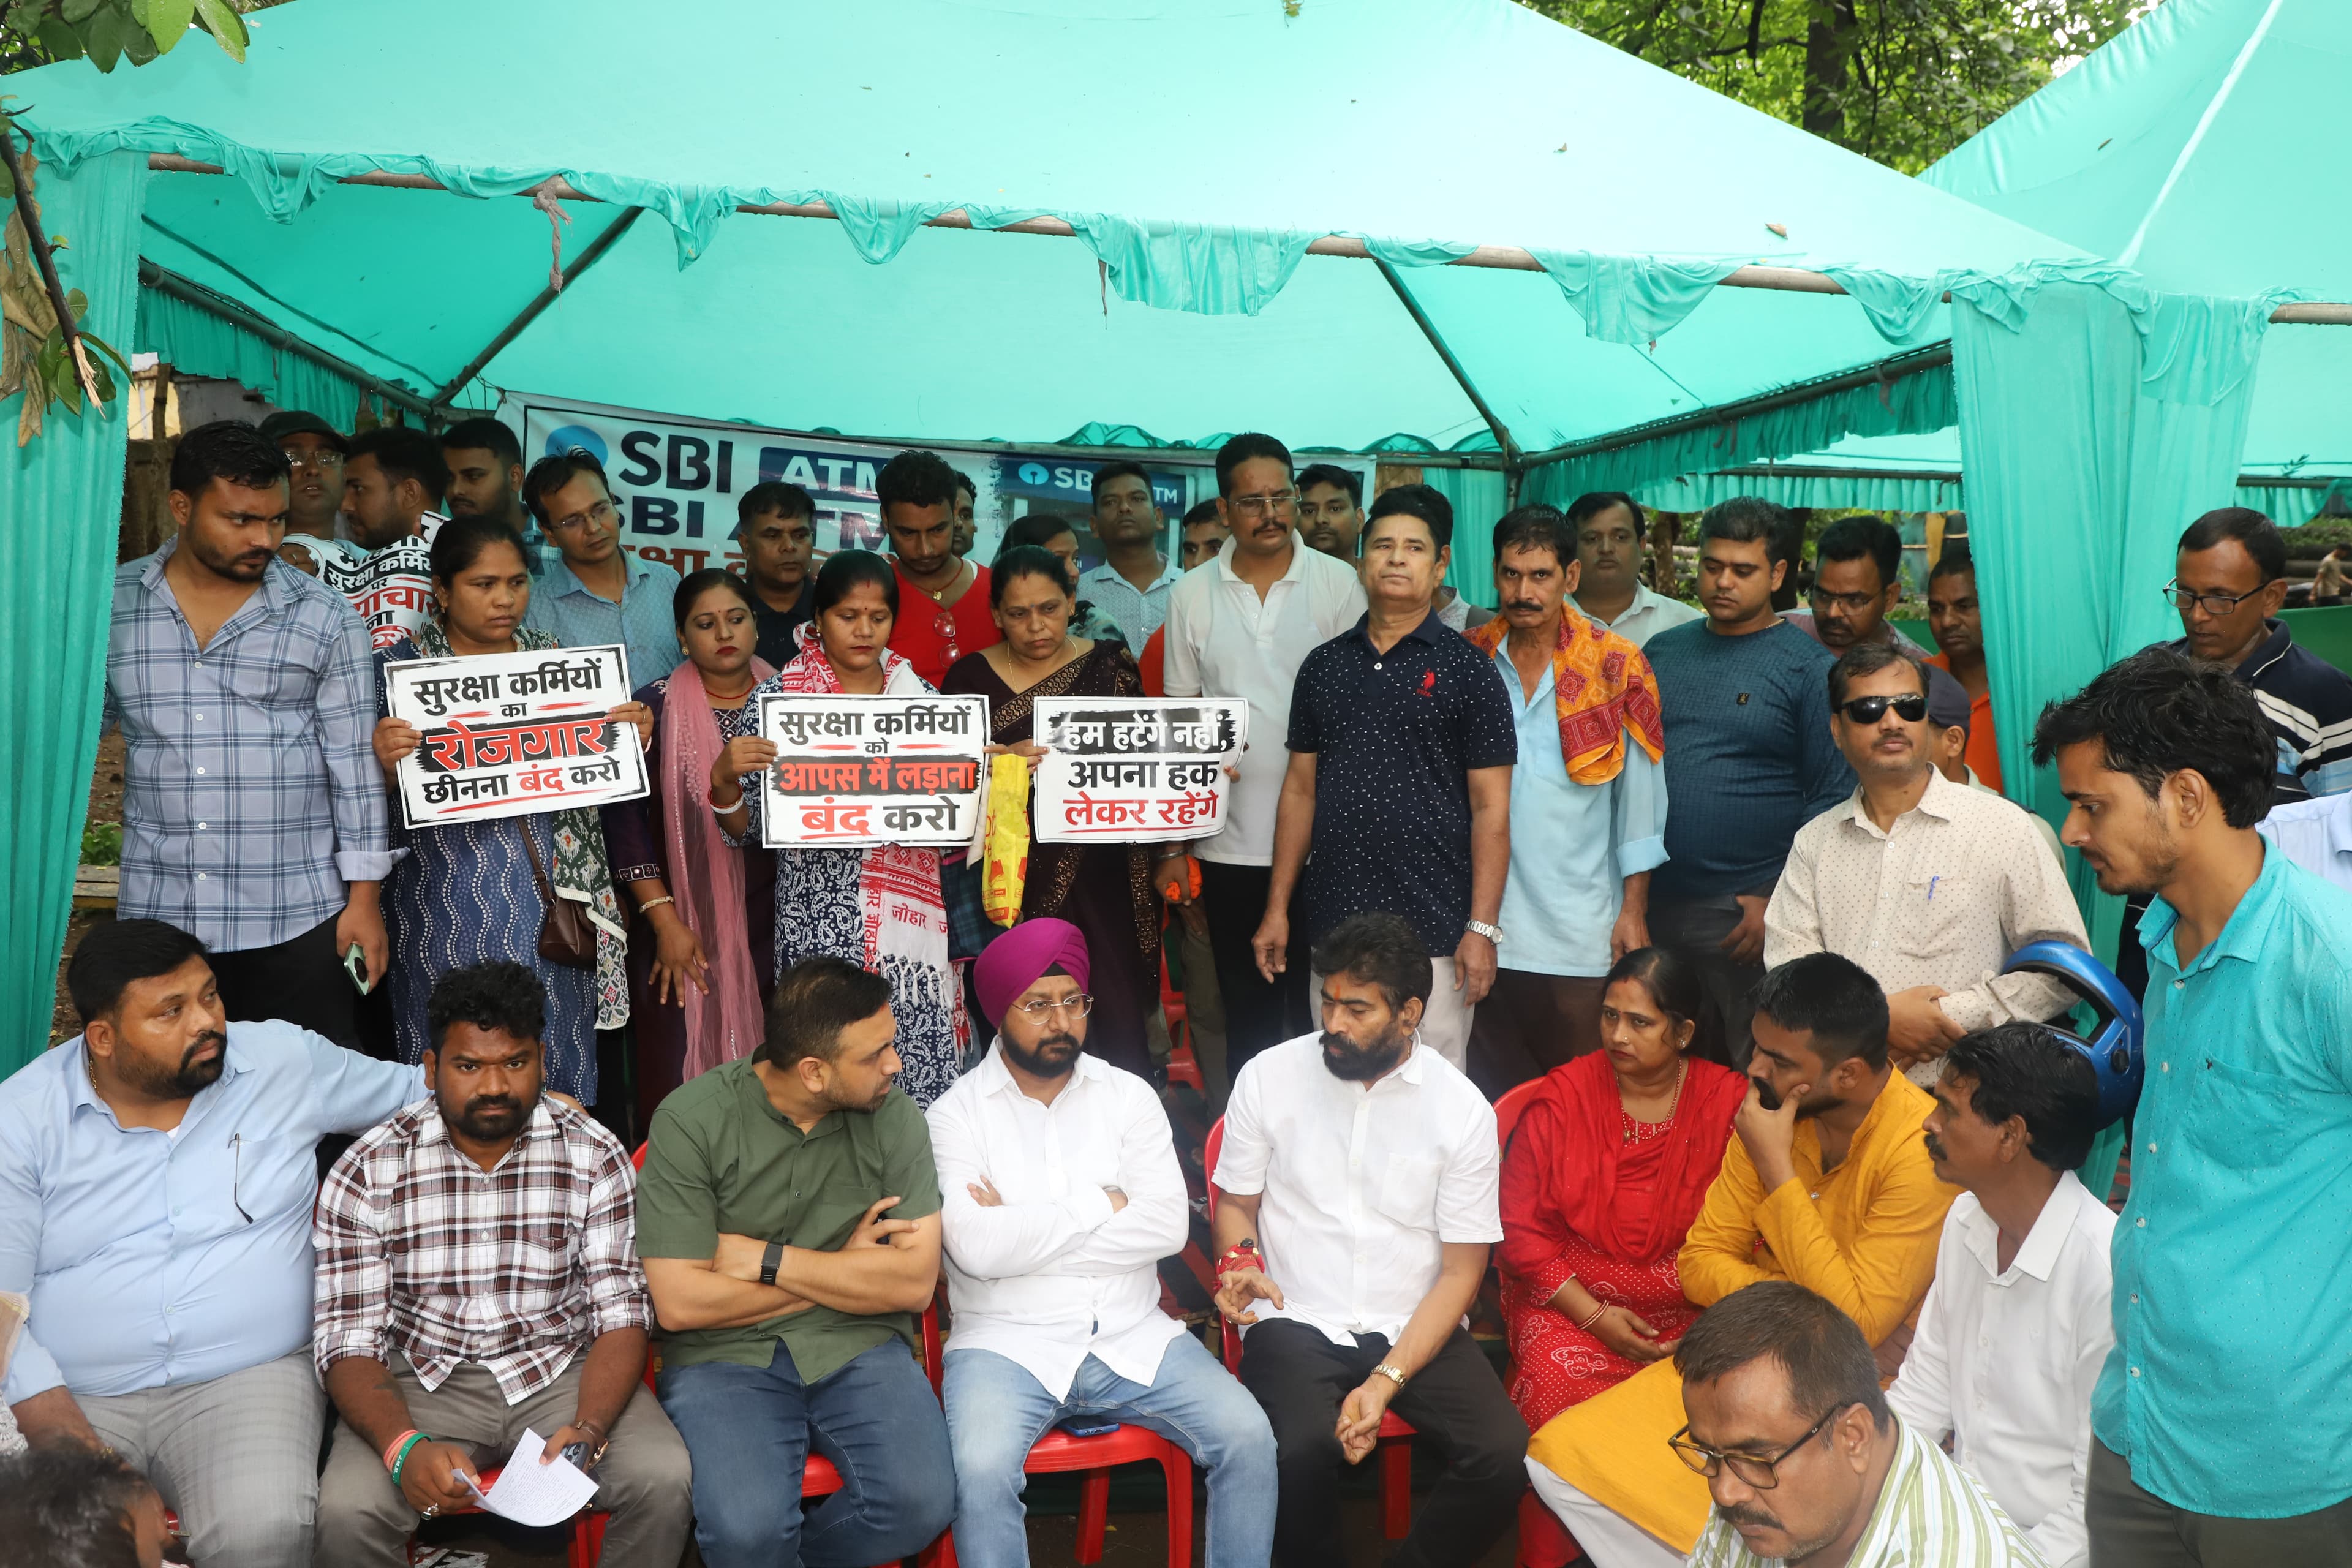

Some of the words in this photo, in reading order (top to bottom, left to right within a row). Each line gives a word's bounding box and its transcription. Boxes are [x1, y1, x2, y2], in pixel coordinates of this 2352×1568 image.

[619, 431, 733, 493] SBI
[614, 495, 705, 538] BI
[328, 565, 376, 592] सुरक्षा
[371, 577, 389, 590] पर
[411, 674, 500, 716] सुरक्षा
[507, 657, 603, 696] कर्मियों
[500, 703, 527, 717] का
[779, 712, 865, 745] सुरक्षा
[873, 704, 972, 736] कर्मियों
[426, 720, 608, 771] रोजगार
[864, 737, 890, 754] को
[1061, 722, 1106, 751] हम
[1111, 712, 1167, 750] हटेंगे
[422, 775, 509, 804] छीनना
[516, 763, 566, 792] बंद
[569, 755, 621, 785] करो
[779, 762, 862, 791] आपस
[867, 757, 892, 791] में
[895, 762, 976, 796] लड़ाना
[1068, 761, 1159, 788] अपना
[1165, 761, 1220, 791] हक
[799, 796, 873, 836] बंद
[883, 796, 960, 831] करो
[1063, 790, 1149, 826] लेकर
[1156, 789, 1219, 824] रहेंगे
[891, 902, 927, 929] जोहार
